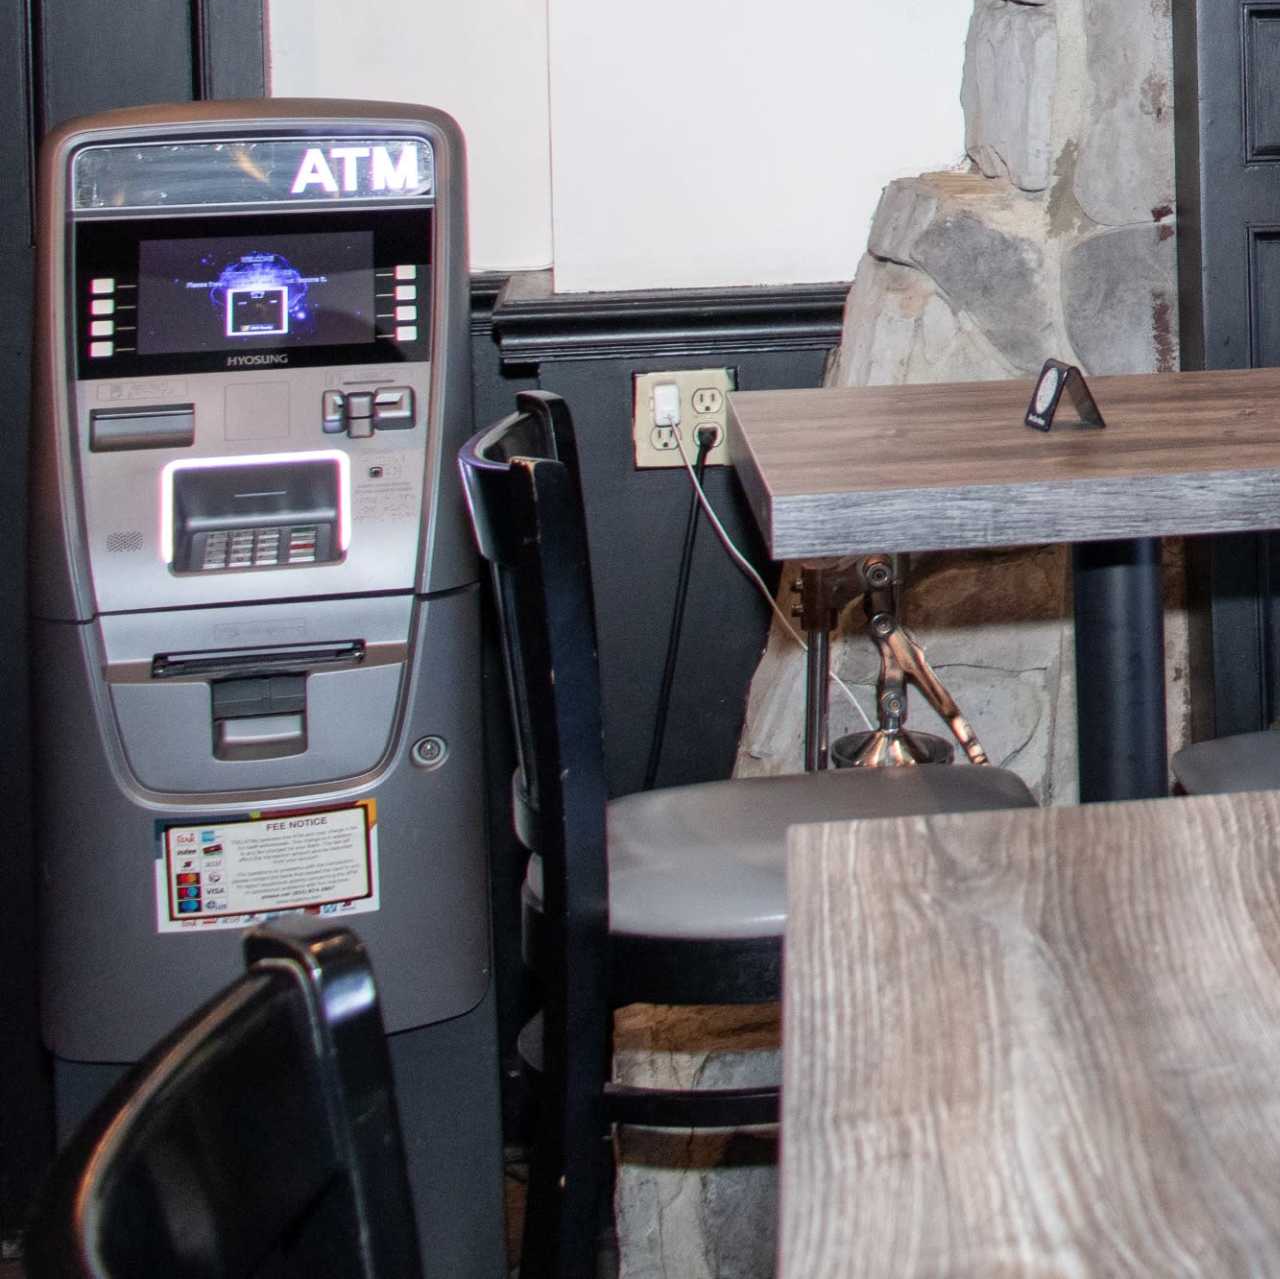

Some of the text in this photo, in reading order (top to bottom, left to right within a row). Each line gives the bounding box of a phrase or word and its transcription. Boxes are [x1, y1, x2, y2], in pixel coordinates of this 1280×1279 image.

[291, 146, 419, 194] ATM
[227, 353, 289, 367] HYOSUNG
[266, 817, 328, 832] FEE NOTICE
